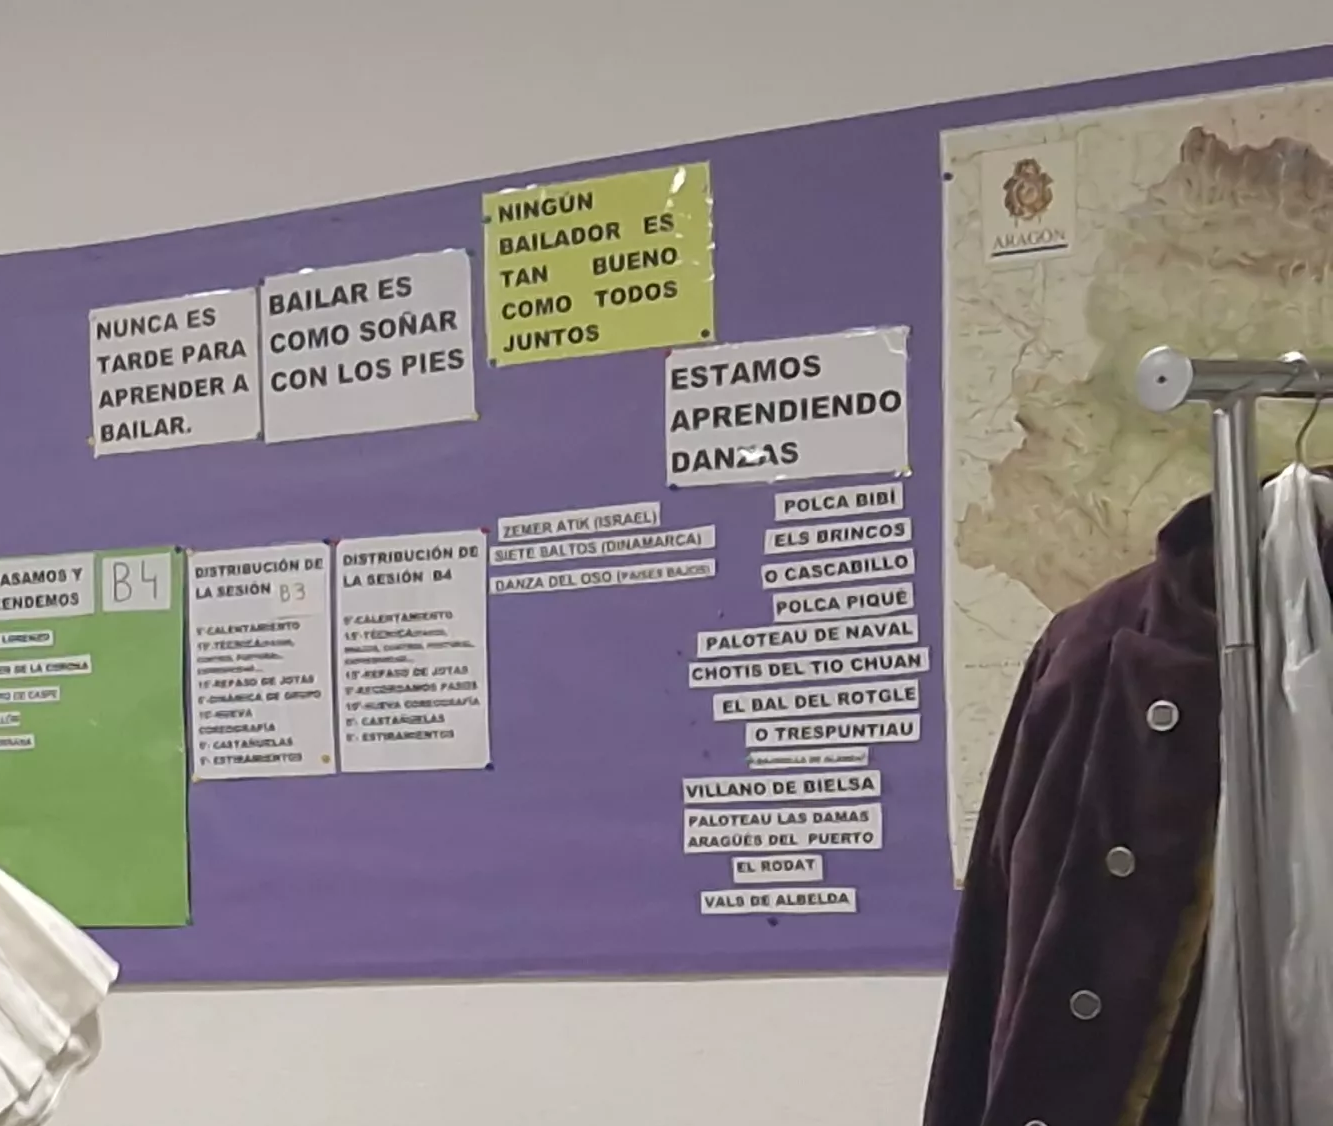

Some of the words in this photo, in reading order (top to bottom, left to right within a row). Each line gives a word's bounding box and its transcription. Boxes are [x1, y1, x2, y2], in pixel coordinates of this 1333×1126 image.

[499, 191, 593, 223] NINGÚN
[499, 221, 621, 255] BAILADOR
[644, 213, 675, 235] ES
[500, 264, 548, 288] TAN
[592, 247, 678, 275] BUENO
[269, 282, 368, 316] BAILAR
[378, 276, 412, 300] ES
[502, 295, 573, 320] COMO
[594, 280, 678, 308] TODOS
[97, 313, 178, 340] NUNCA
[187, 308, 216, 328] ES
[270, 324, 349, 354] COMO
[359, 310, 458, 342] SOÑAR
[503, 324, 600, 352] JUNTOS
[97, 348, 173, 374] TARDE
[183, 339, 247, 364] PARA
[271, 365, 327, 392] CON
[338, 358, 391, 384] LOS
[401, 348, 464, 376] PIES
[671, 354, 821, 390] ESTAMOS
[99, 376, 225, 409] APRENDER
[233, 374, 249, 393] A
[670, 389, 902, 432] APRENDIENDO
[101, 416, 192, 443] BAILAR.
[784, 494, 849, 513] POLCA
[503, 522, 553, 538] ZEMER
[557, 517, 590, 532] ATIK
[594, 511, 657, 529] (ISRAEL)
[774, 531, 809, 547] ELS
[817, 522, 906, 543] BRINCOS
[343, 544, 453, 566] DISTRIBUCIÓN
[458, 545, 479, 559] DE
[494, 548, 534, 562] SIETE
[540, 542, 597, 557] SALTOS
[601, 532, 702, 553] (DINAMARCA)
[72, 567, 83, 581] Y
[113, 559, 158, 602] B4
[195, 558, 299, 579] DISTRIBUCIÓN
[304, 558, 324, 571] DE
[343, 575, 362, 588] LA
[367, 569, 424, 586] SESIÓN
[433, 569, 452, 582] B4
[495, 577, 545, 592] DANZA
[548, 575, 575, 588] DEL
[580, 571, 612, 586] OSO
[765, 570, 778, 583] O
[785, 555, 909, 581] CASCABILLO
[196, 586, 213, 600] LA
[216, 581, 271, 598] SESIÓN
[776, 597, 841, 615] POLCA
[847, 588, 908, 608] PIQUÉ
[706, 630, 807, 651] PALOTEAU
[815, 626, 839, 642] DE
[846, 622, 914, 640] NAVAL
[30, 662, 43, 673] LA
[691, 664, 763, 681] CHOTIS
[769, 661, 805, 677] DEL
[810, 659, 843, 674] TIO
[850, 654, 921, 671] CHUAN
[722, 699, 745, 714] EL
[752, 696, 788, 711] BAL
[795, 694, 831, 709] DEL
[838, 687, 916, 705] ROTGLE
[755, 728, 768, 741] O
[775, 722, 914, 741] TRESPUNTIAU
[686, 782, 766, 798] VILLANO
[773, 780, 796, 795] DE
[804, 777, 875, 794] BIELSA
[689, 813, 772, 827] PALOTEAU
[778, 811, 807, 825] LAS
[813, 811, 869, 824] DAMAS
[768, 834, 798, 846] DEL
[808, 832, 873, 845] PUERTO
[737, 862, 755, 872] EL
[761, 858, 815, 872] RODAT
[704, 895, 744, 908] VALS
[750, 895, 770, 907] DE
[776, 893, 849, 905] ALBELDA
